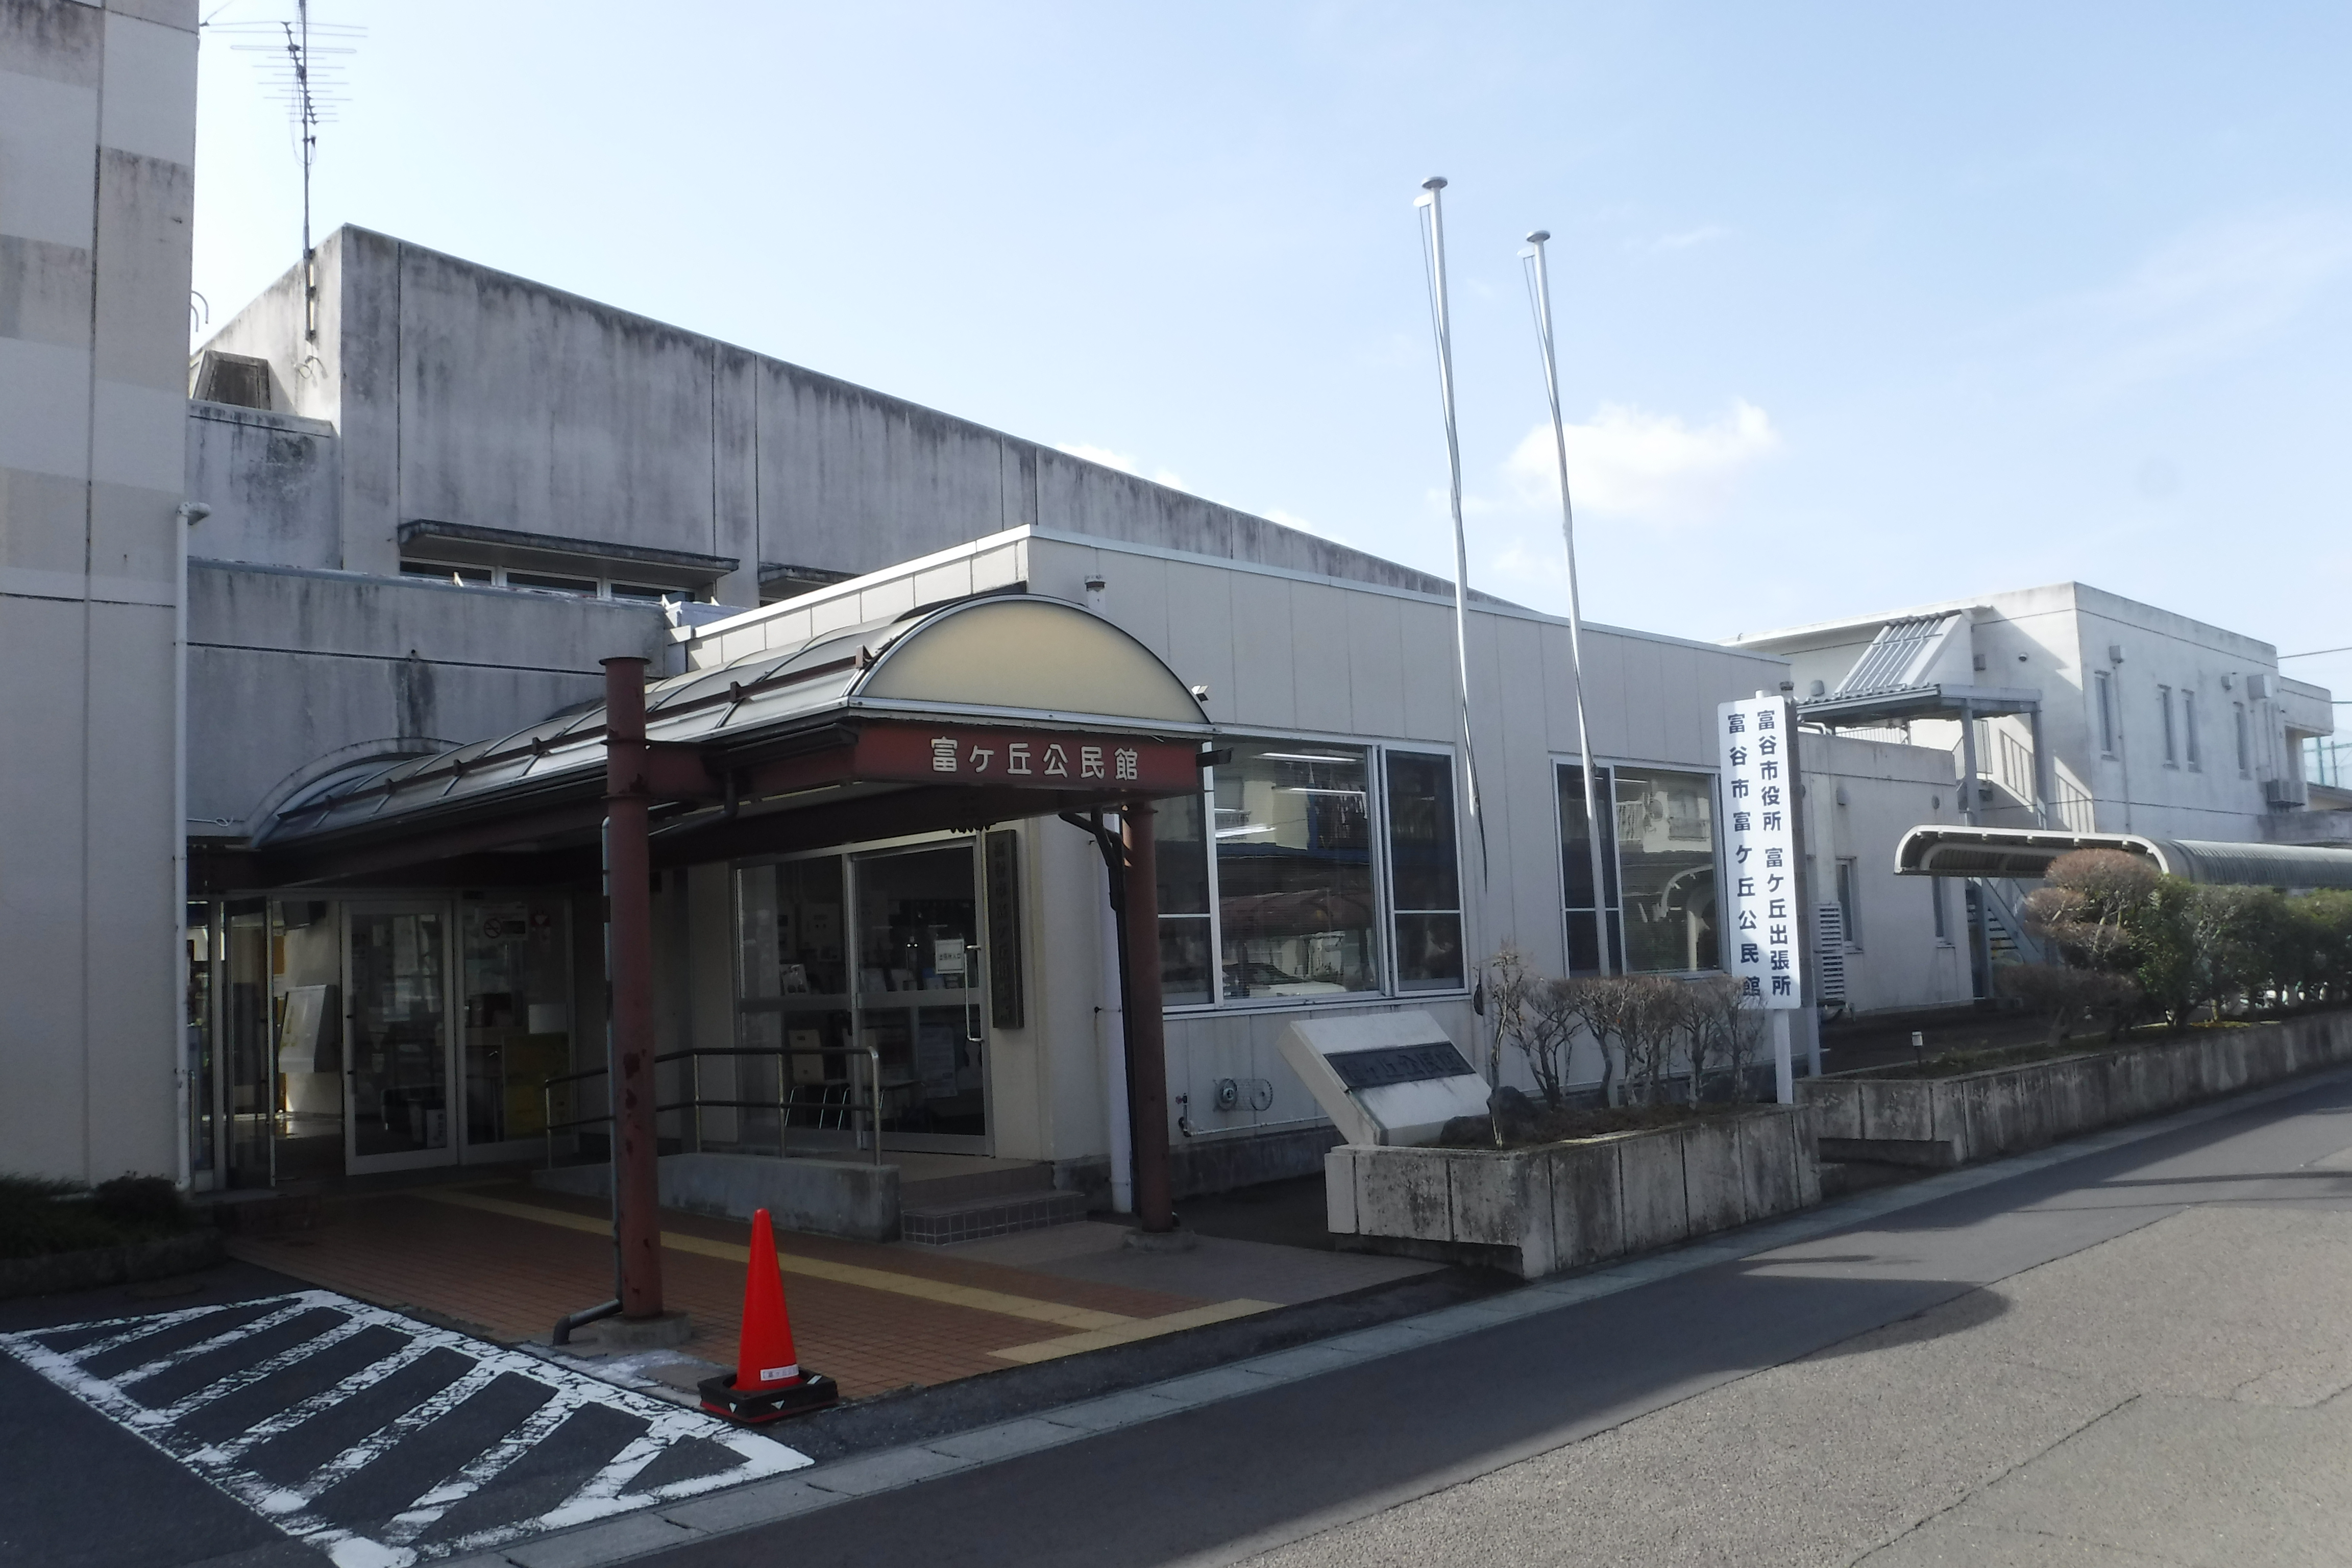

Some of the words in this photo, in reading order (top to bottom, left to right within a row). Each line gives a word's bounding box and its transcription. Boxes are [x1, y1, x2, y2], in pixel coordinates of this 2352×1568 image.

[929, 736, 1139, 781] 富ケ丘公民館
[1757, 709, 1782, 832] 富谷市役所
[1727, 713, 1760, 996] 富谷市富ケ丘公民館
[1765, 846, 1792, 996] 富ケ丘出張所
